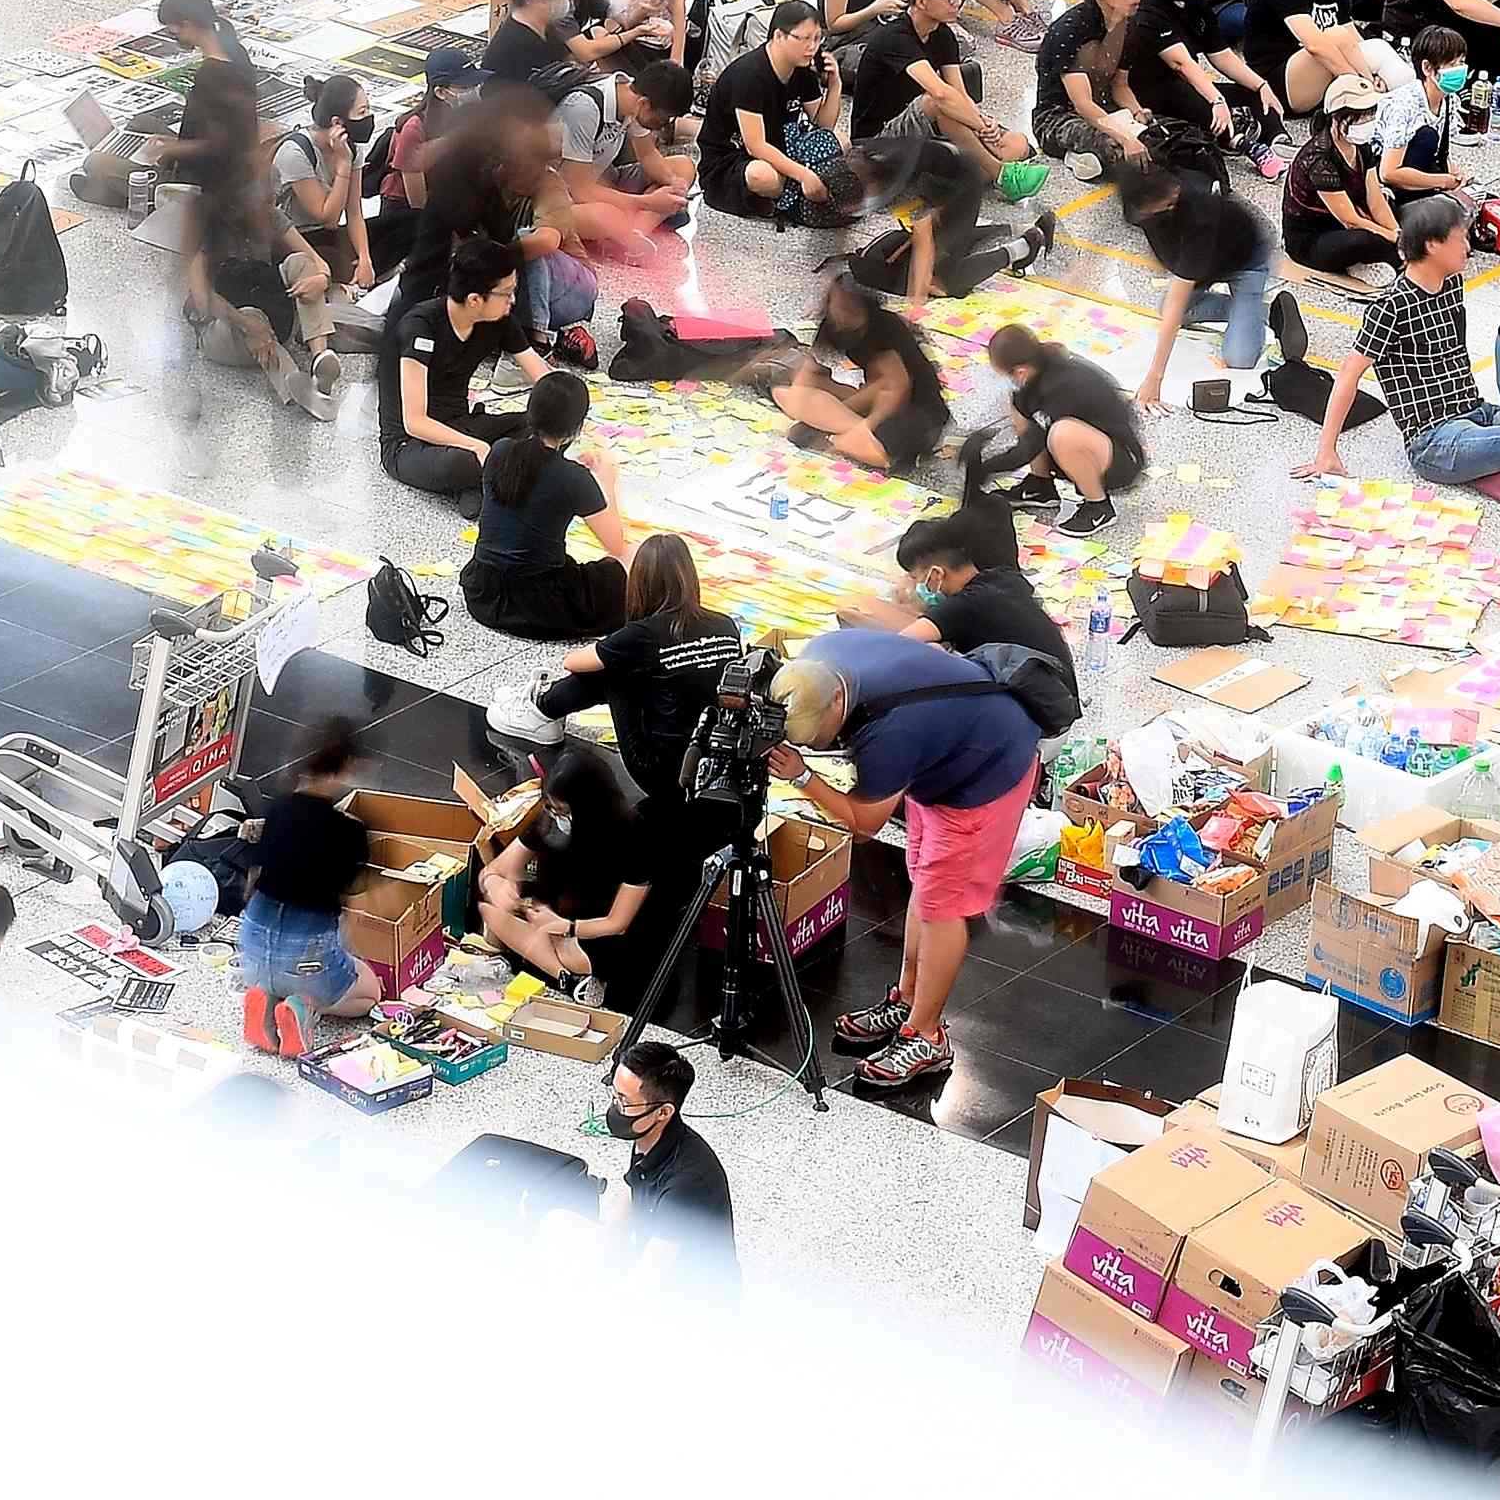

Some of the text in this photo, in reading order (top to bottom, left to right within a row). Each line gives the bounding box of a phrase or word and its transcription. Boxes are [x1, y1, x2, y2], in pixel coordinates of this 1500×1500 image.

[192, 743, 228, 774] QIMA
[820, 896, 845, 924] vita
[1121, 901, 1161, 933] vita
[791, 917, 816, 946] vita
[1170, 918, 1210, 950] vita
[1233, 918, 1252, 941] vita
[409, 949, 433, 978] vita
[1091, 1251, 1137, 1295] vita
[1185, 1309, 1232, 1349] vita
